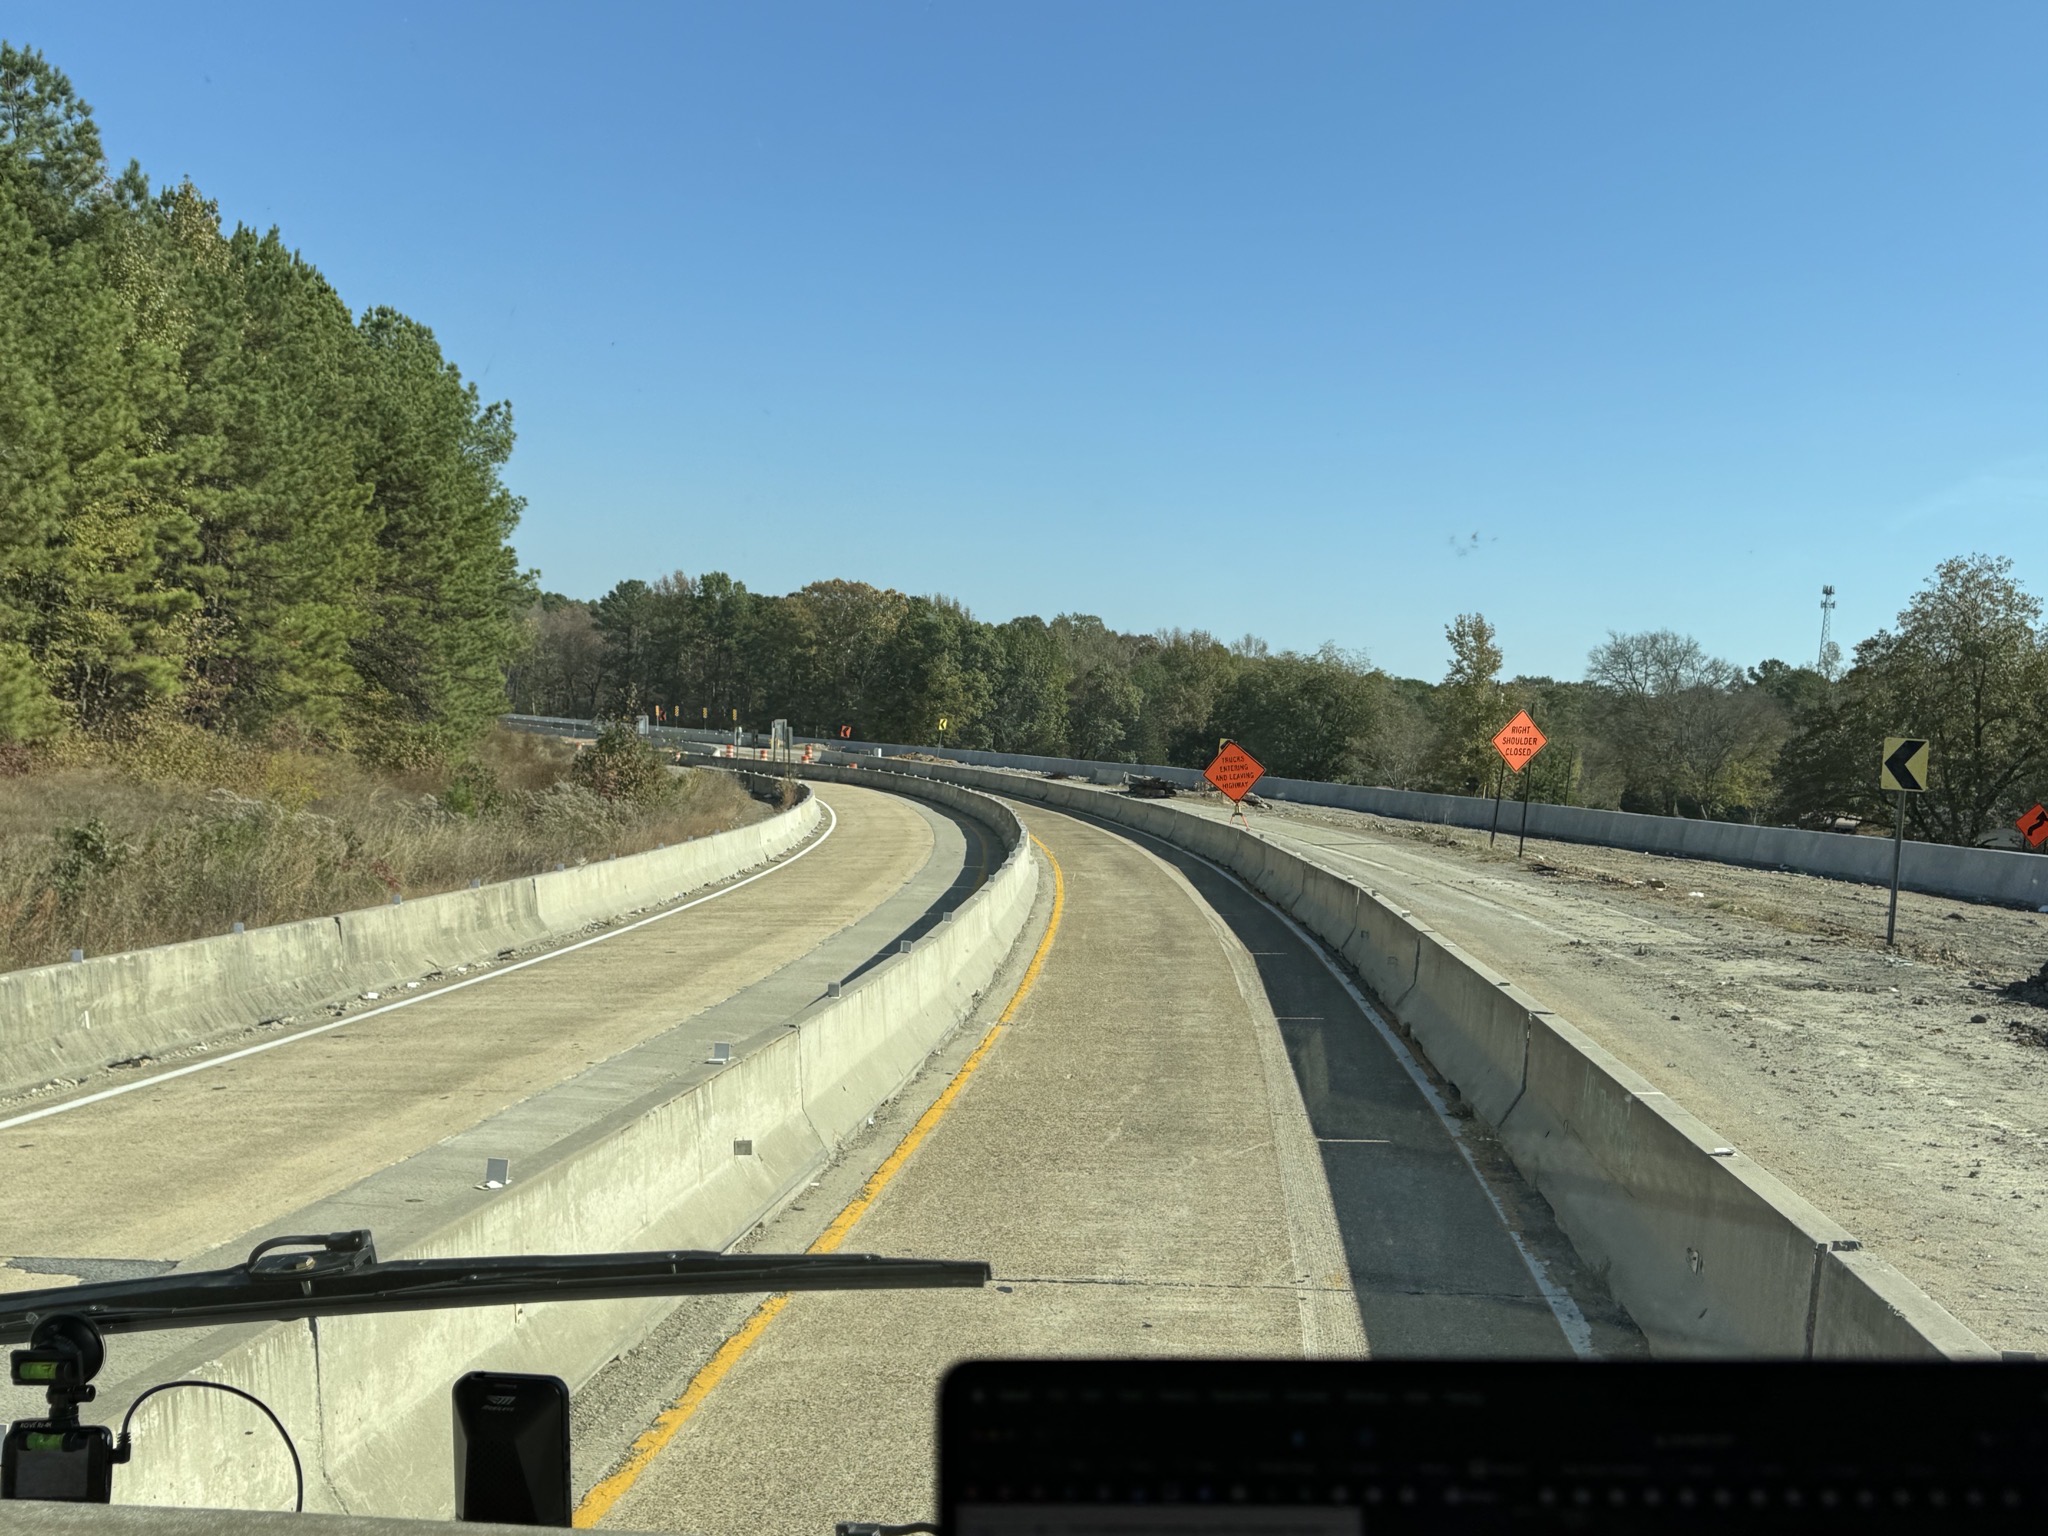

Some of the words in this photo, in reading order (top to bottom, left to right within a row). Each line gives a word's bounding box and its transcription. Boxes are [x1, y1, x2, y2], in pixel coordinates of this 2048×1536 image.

[1511, 726, 1531, 734] RIGHT
[1502, 737, 1537, 746] SHOULDER
[1505, 748, 1531, 756] CLOSED
[1220, 764, 1249, 773] ENTERING
[1229, 772, 1254, 780] LEAVING
[1222, 781, 1249, 789] HIGHWAY
